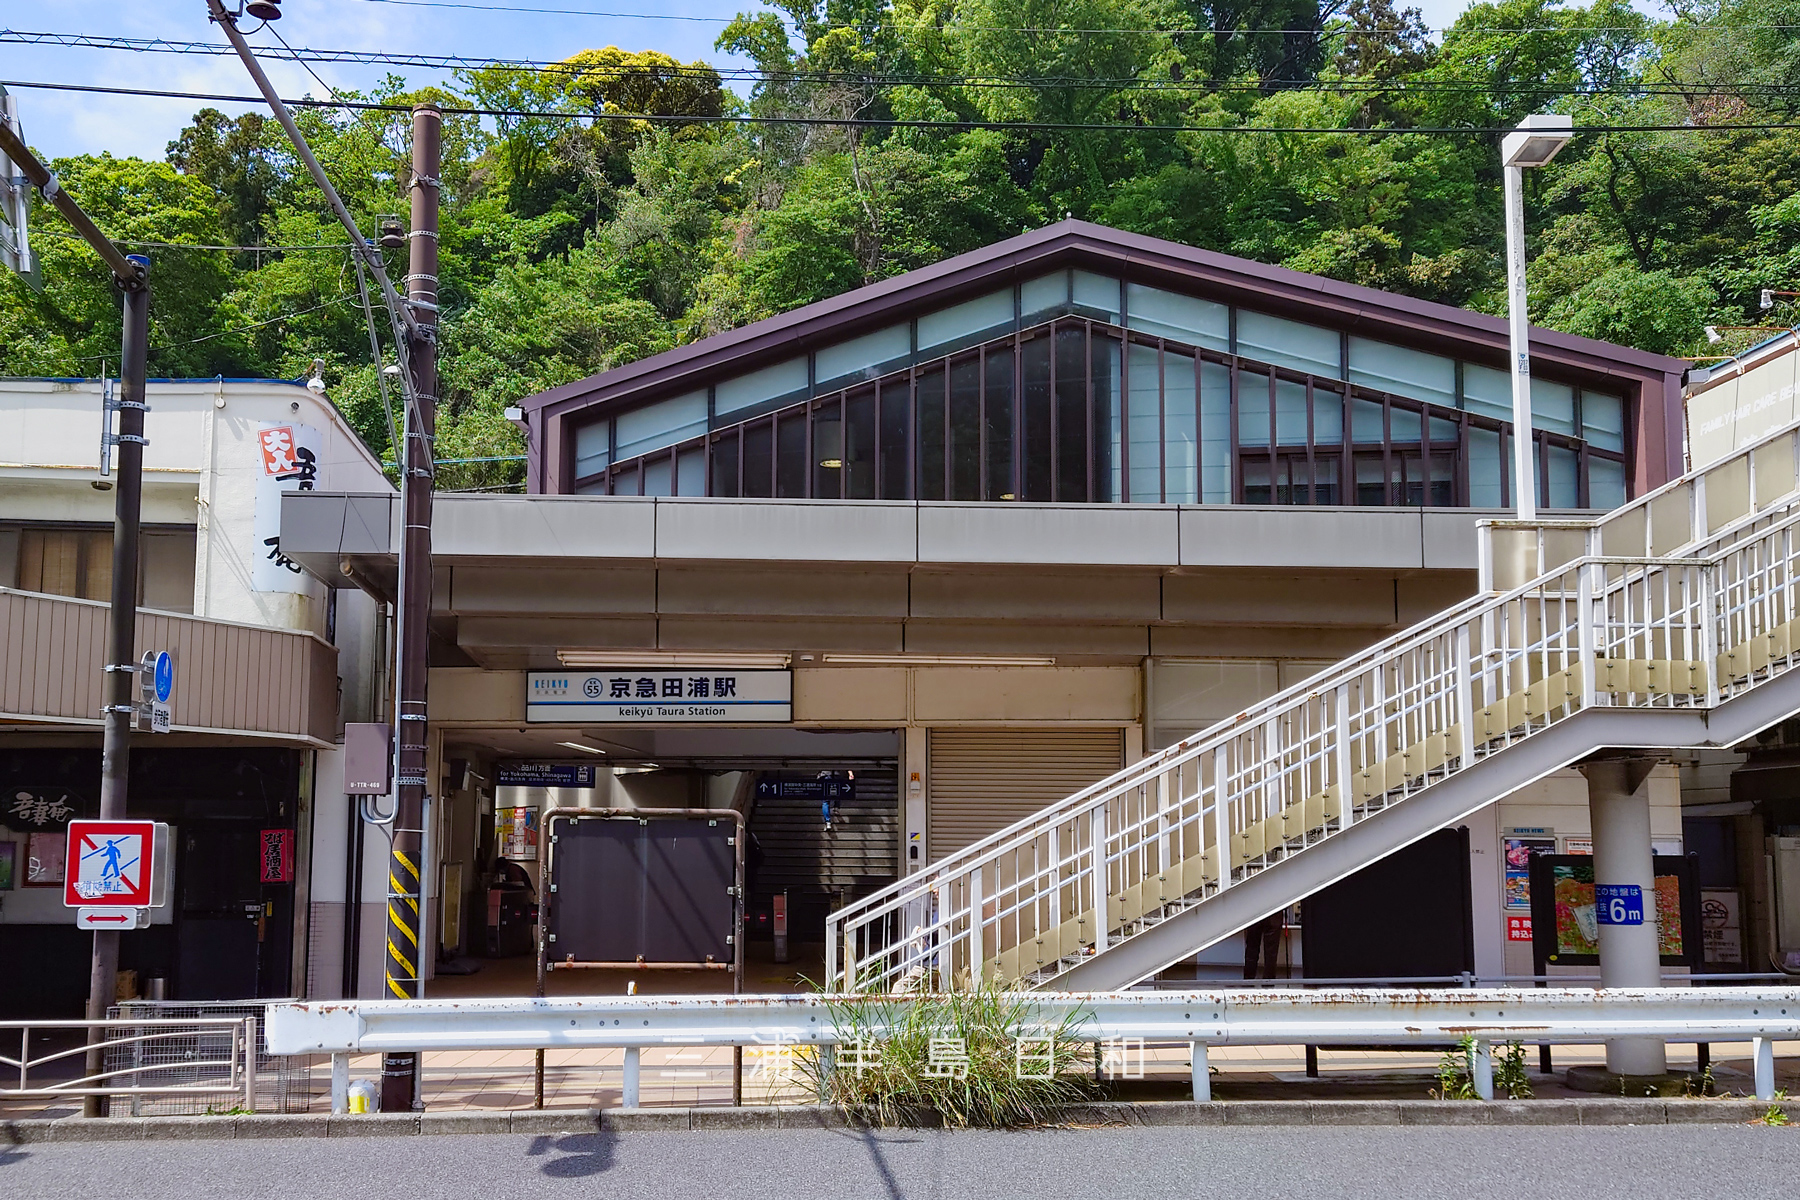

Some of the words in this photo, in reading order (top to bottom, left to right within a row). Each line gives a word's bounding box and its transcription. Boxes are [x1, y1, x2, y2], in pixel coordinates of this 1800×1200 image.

[534, 679, 568, 689] KEIKYU
[609, 677, 737, 698] 京急田浦駅
[586, 685, 599, 695] 55
[656, 706, 685, 716] Taura
[688, 706, 726, 716] Station
[771, 783, 777, 795] 1
